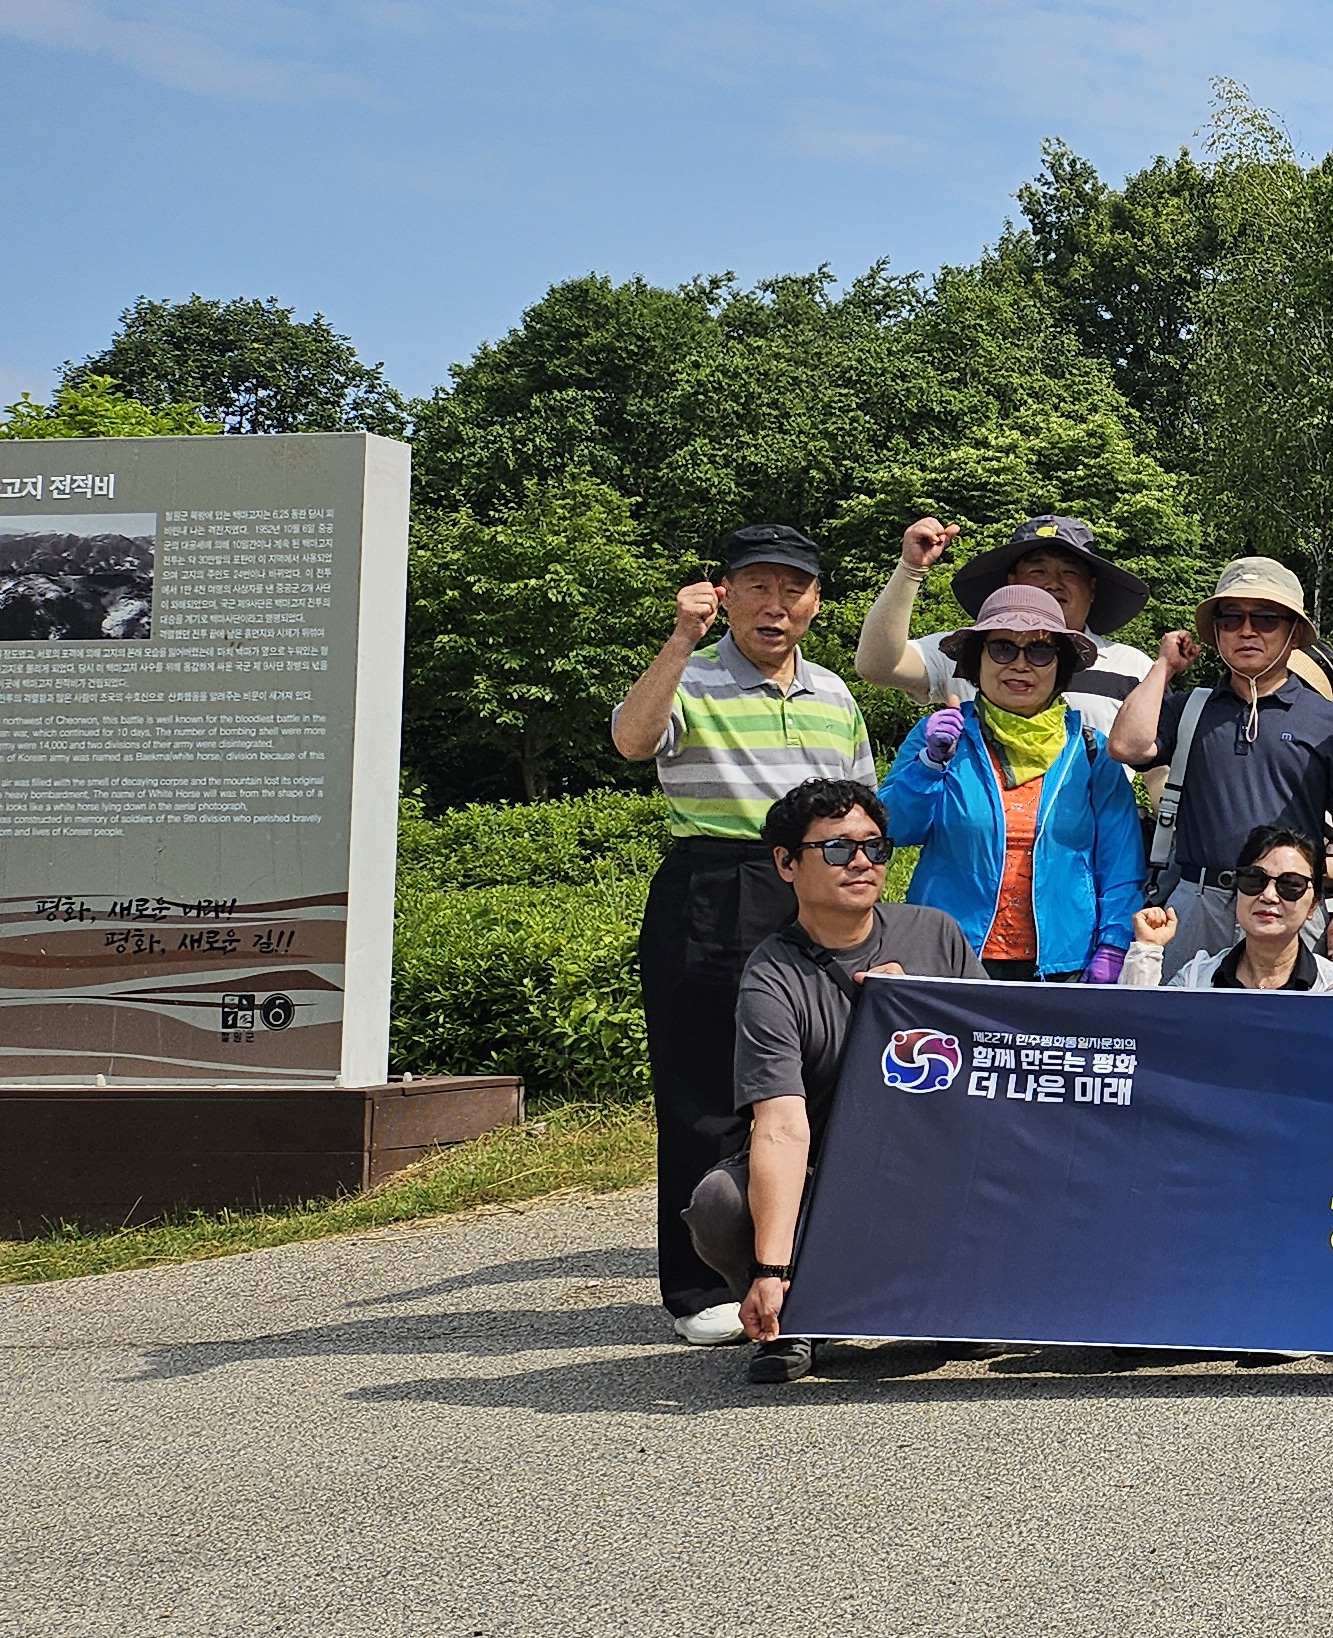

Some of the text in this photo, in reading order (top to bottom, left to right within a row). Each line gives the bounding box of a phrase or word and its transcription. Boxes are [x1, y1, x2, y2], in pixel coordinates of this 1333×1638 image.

[0, 474, 115, 499] 고지 전적비
[3, 717, 42, 725] northwest
[44, 716, 54, 725] of
[56, 716, 99, 724] Cheorwon,
[103, 716, 118, 724] this
[120, 716, 144, 724] battle
[146, 715, 154, 724] is
[156, 715, 173, 723] well
[206, 715, 217, 723] for
[220, 715, 233, 723] the
[235, 715, 274, 723] bloodiest
[277, 715, 300, 723] battle
[303, 714, 310, 722] in
[34, 896, 97, 925] 평화,
[107, 896, 171, 921] 새로운
[104, 928, 295, 955] 평화, 새로운 길!!
[972, 1031, 1137, 1050] 제22기 민주평화통일자문회의
[972, 1046, 1138, 1075] 함께 만드는 평화
[967, 1070, 1133, 1106] 더 나은 미래
